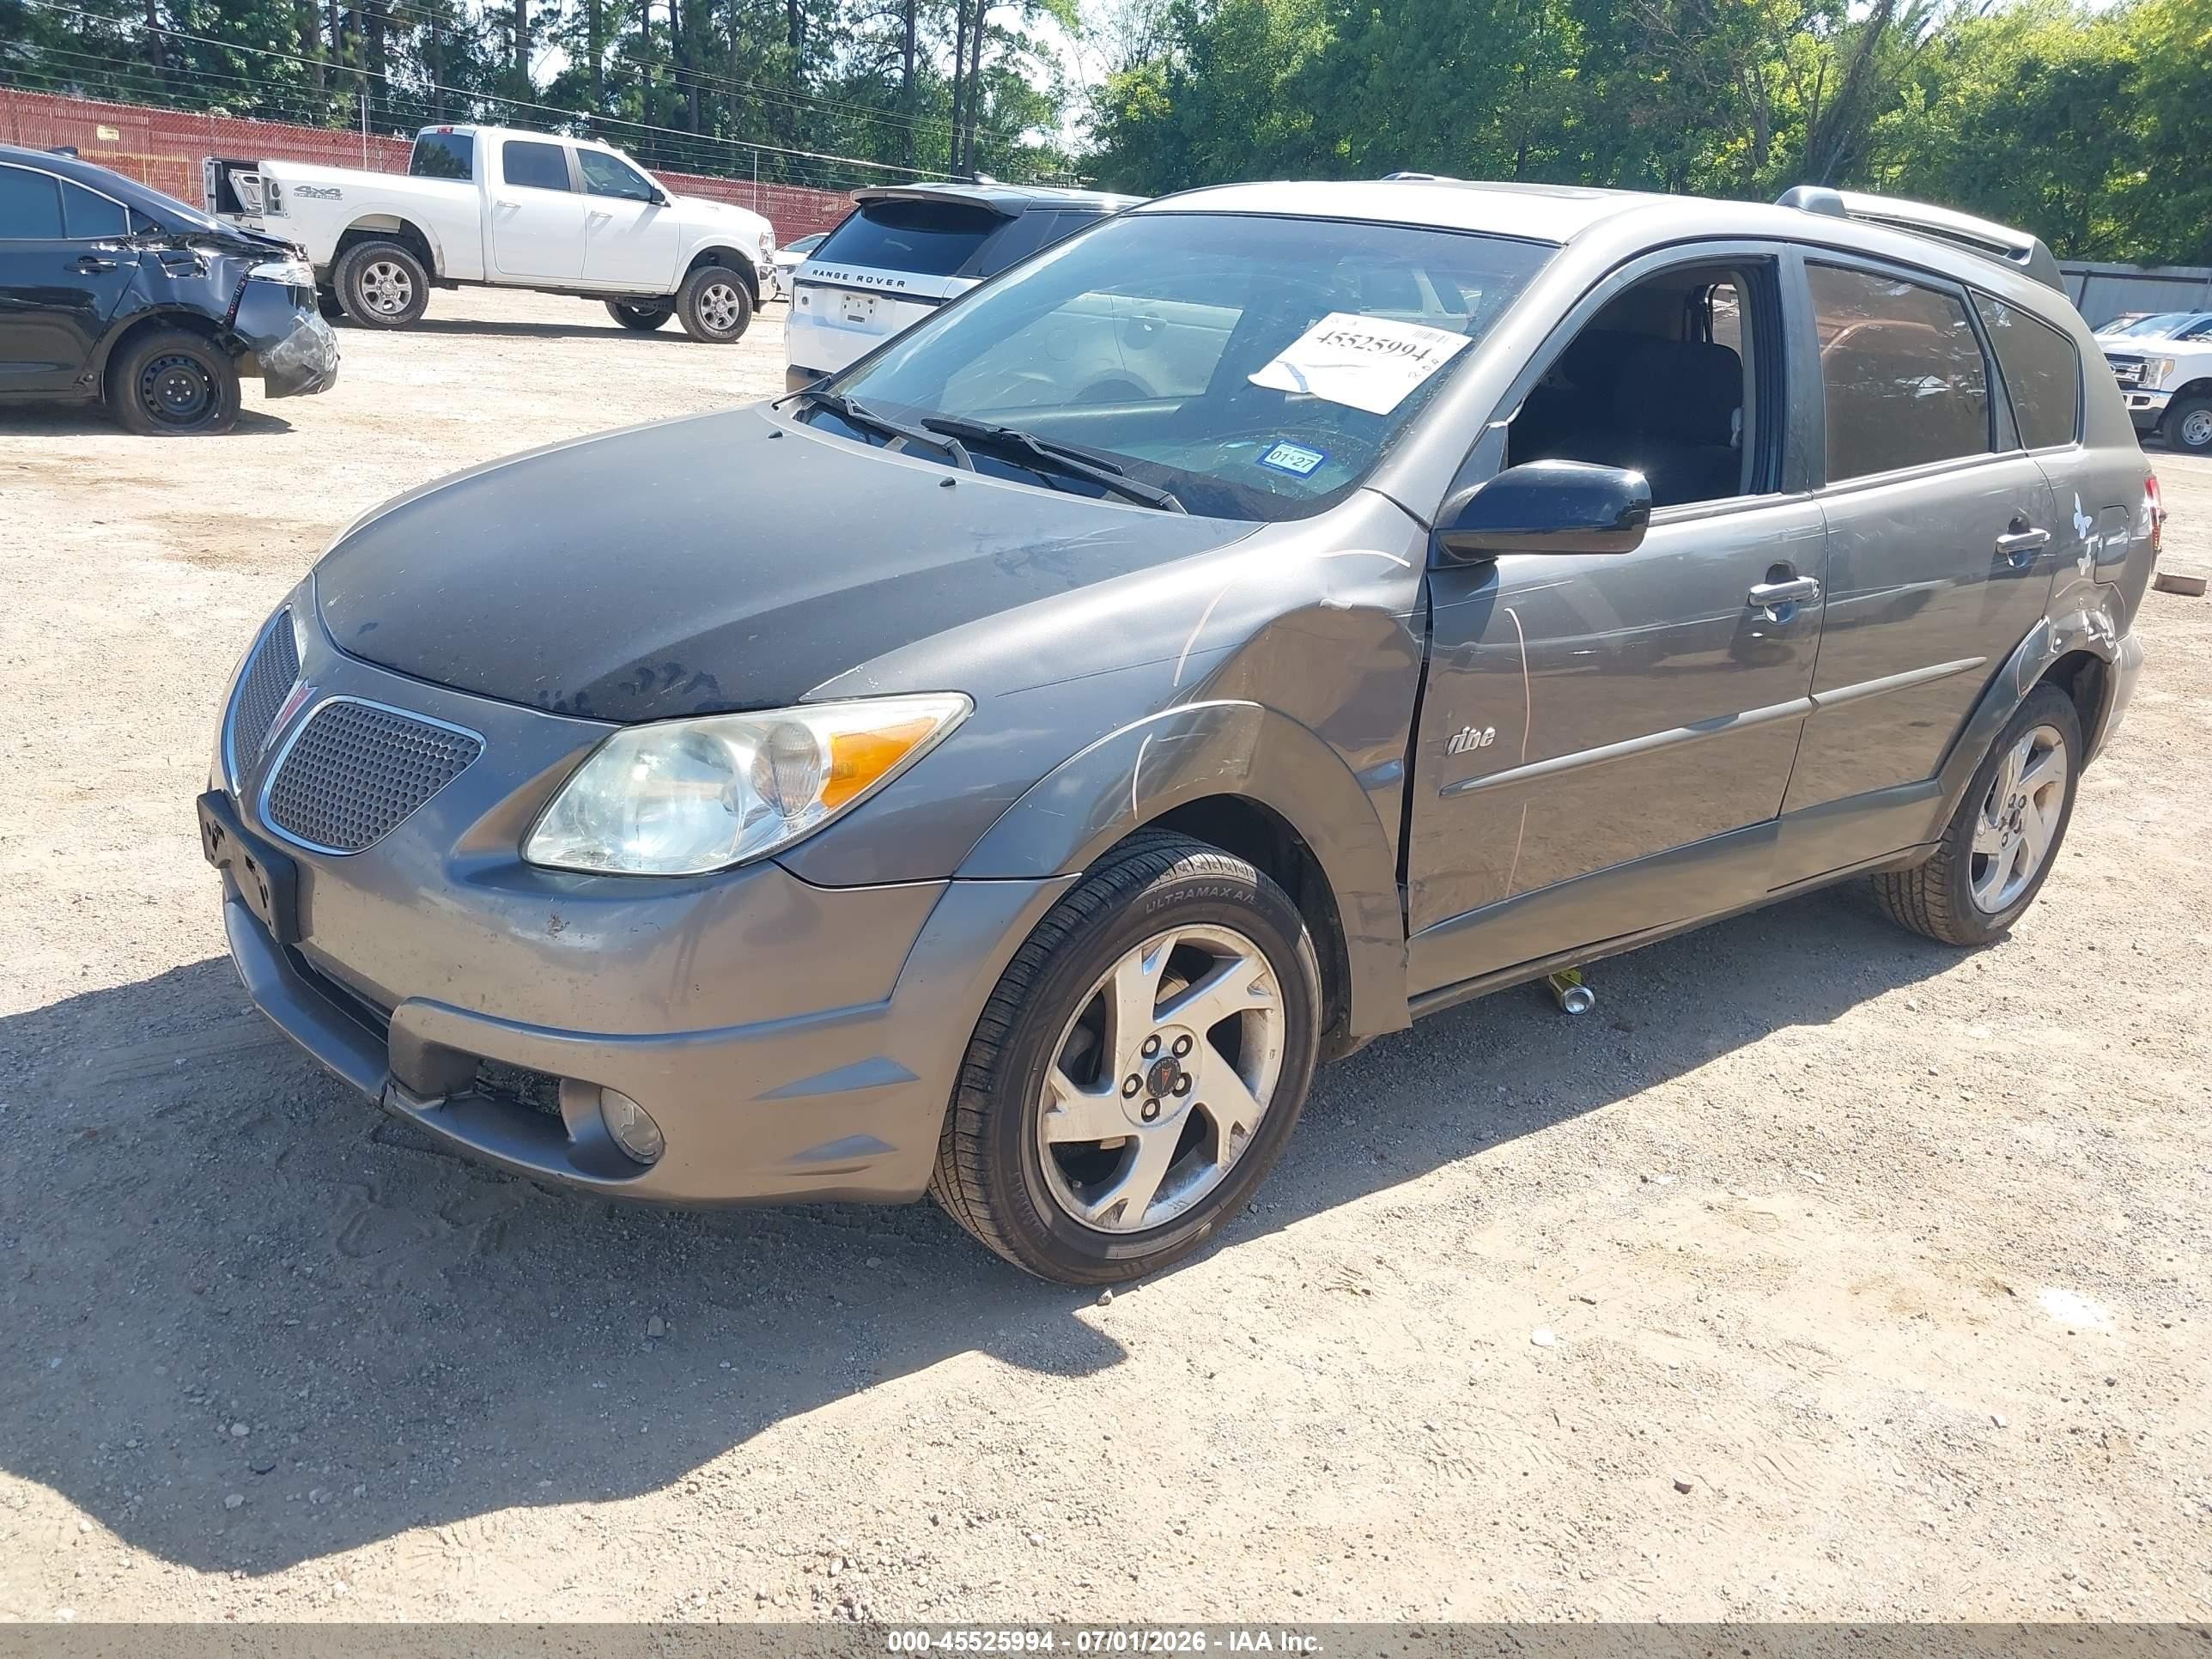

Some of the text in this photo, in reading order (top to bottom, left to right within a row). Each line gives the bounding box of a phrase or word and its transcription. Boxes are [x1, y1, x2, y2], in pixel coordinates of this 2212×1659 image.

[811, 269, 906, 288] RANGE ROVER
[1316, 331, 1433, 362] 45525994
[1270, 450, 1290, 463] 01
[1291, 457, 1316, 469] 27
[1146, 885, 1231, 915] ULTRAMAX
